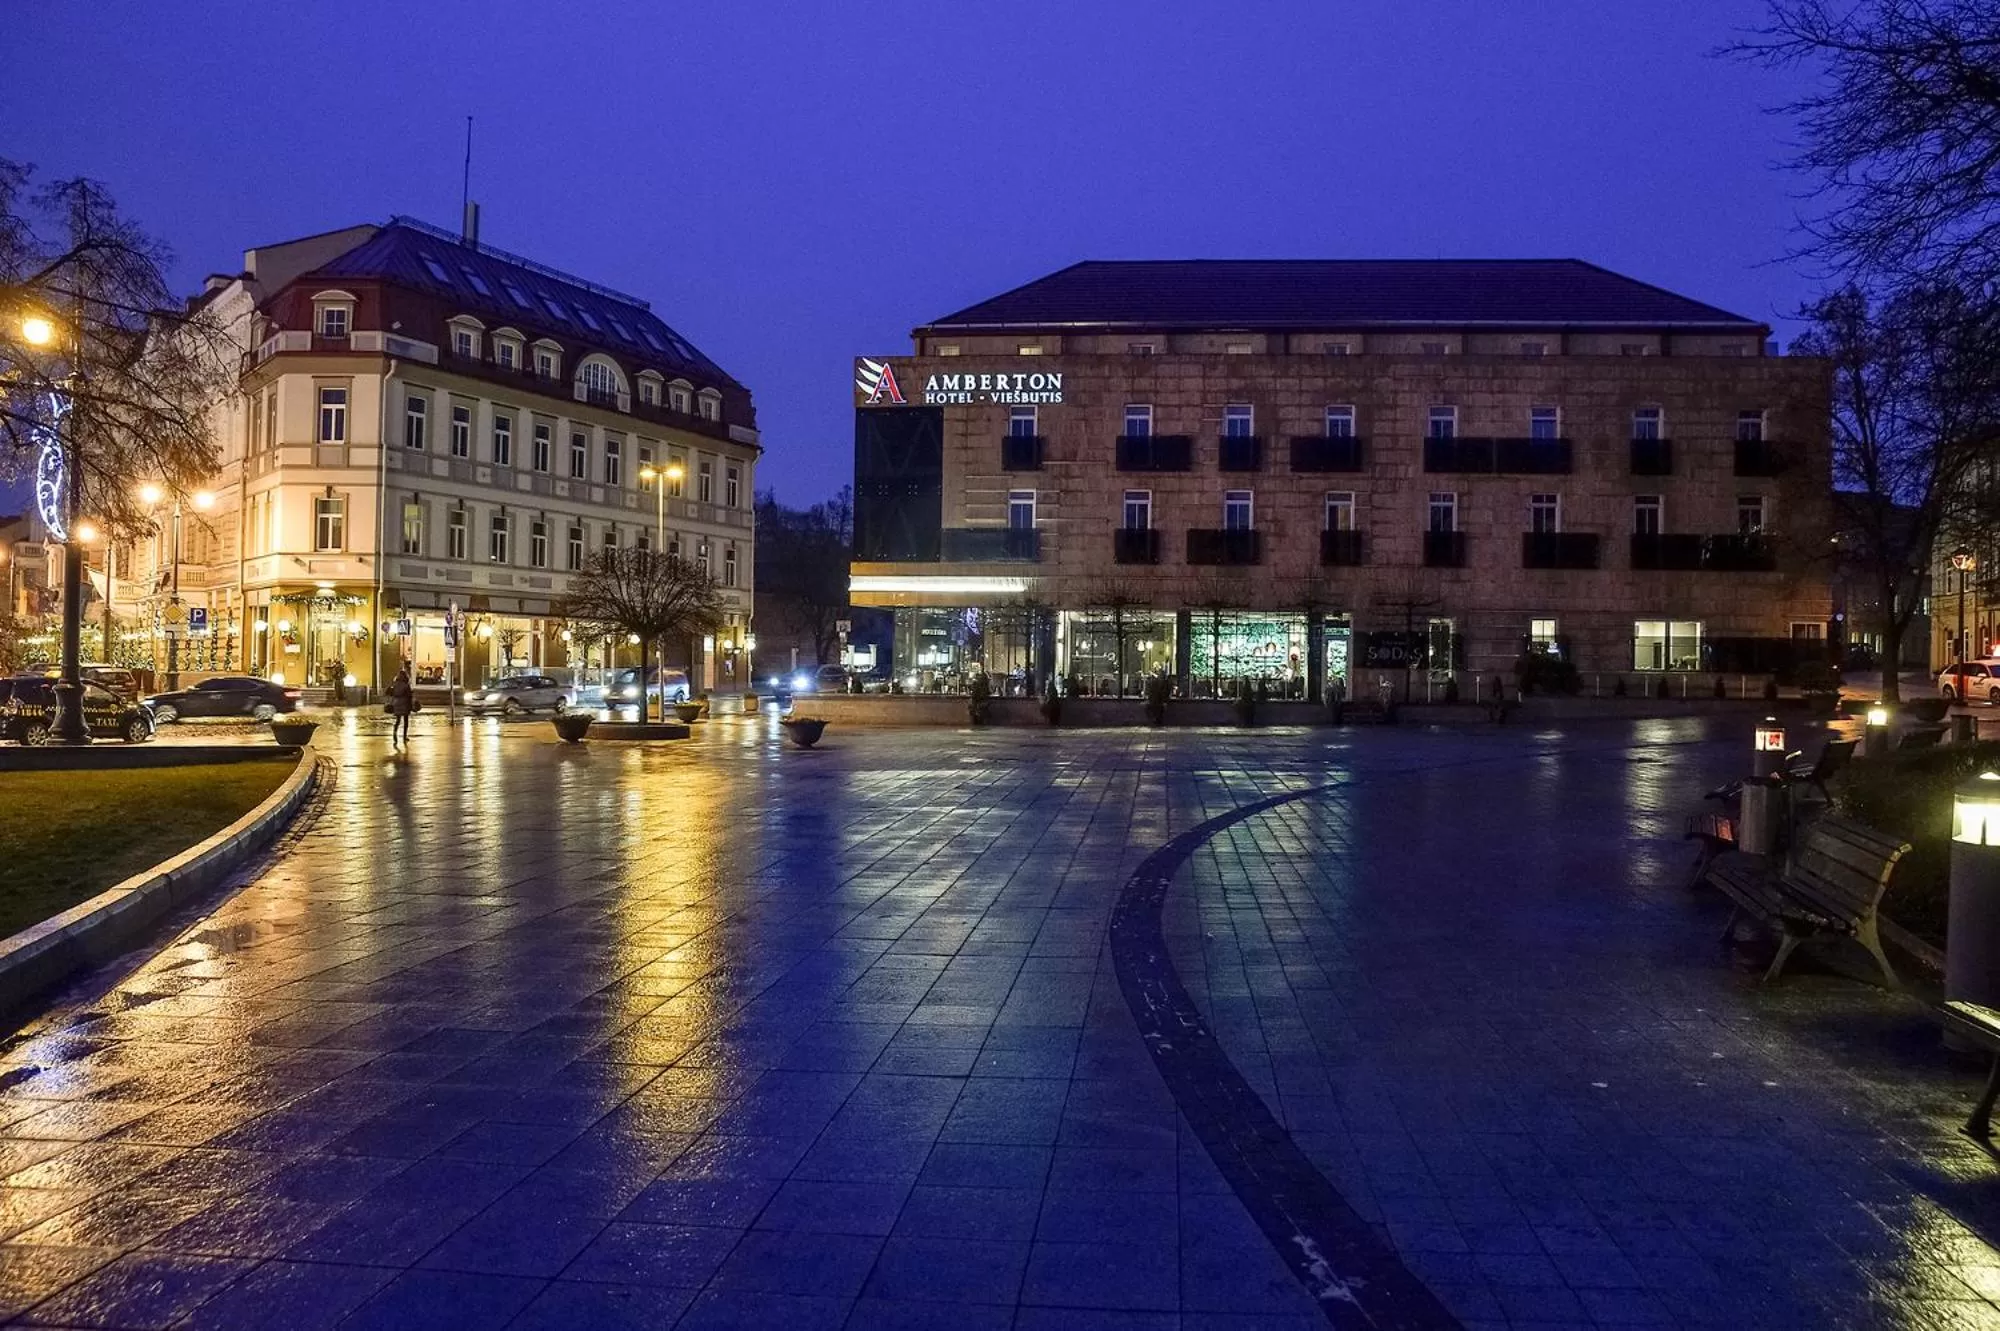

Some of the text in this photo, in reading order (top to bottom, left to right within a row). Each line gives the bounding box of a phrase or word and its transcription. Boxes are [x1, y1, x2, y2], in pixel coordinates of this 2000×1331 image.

[926, 374, 1062, 391] AMBERTON
[926, 389, 1063, 404] HOTEL VIEŠBUTIS
[193, 609, 204, 622] P
